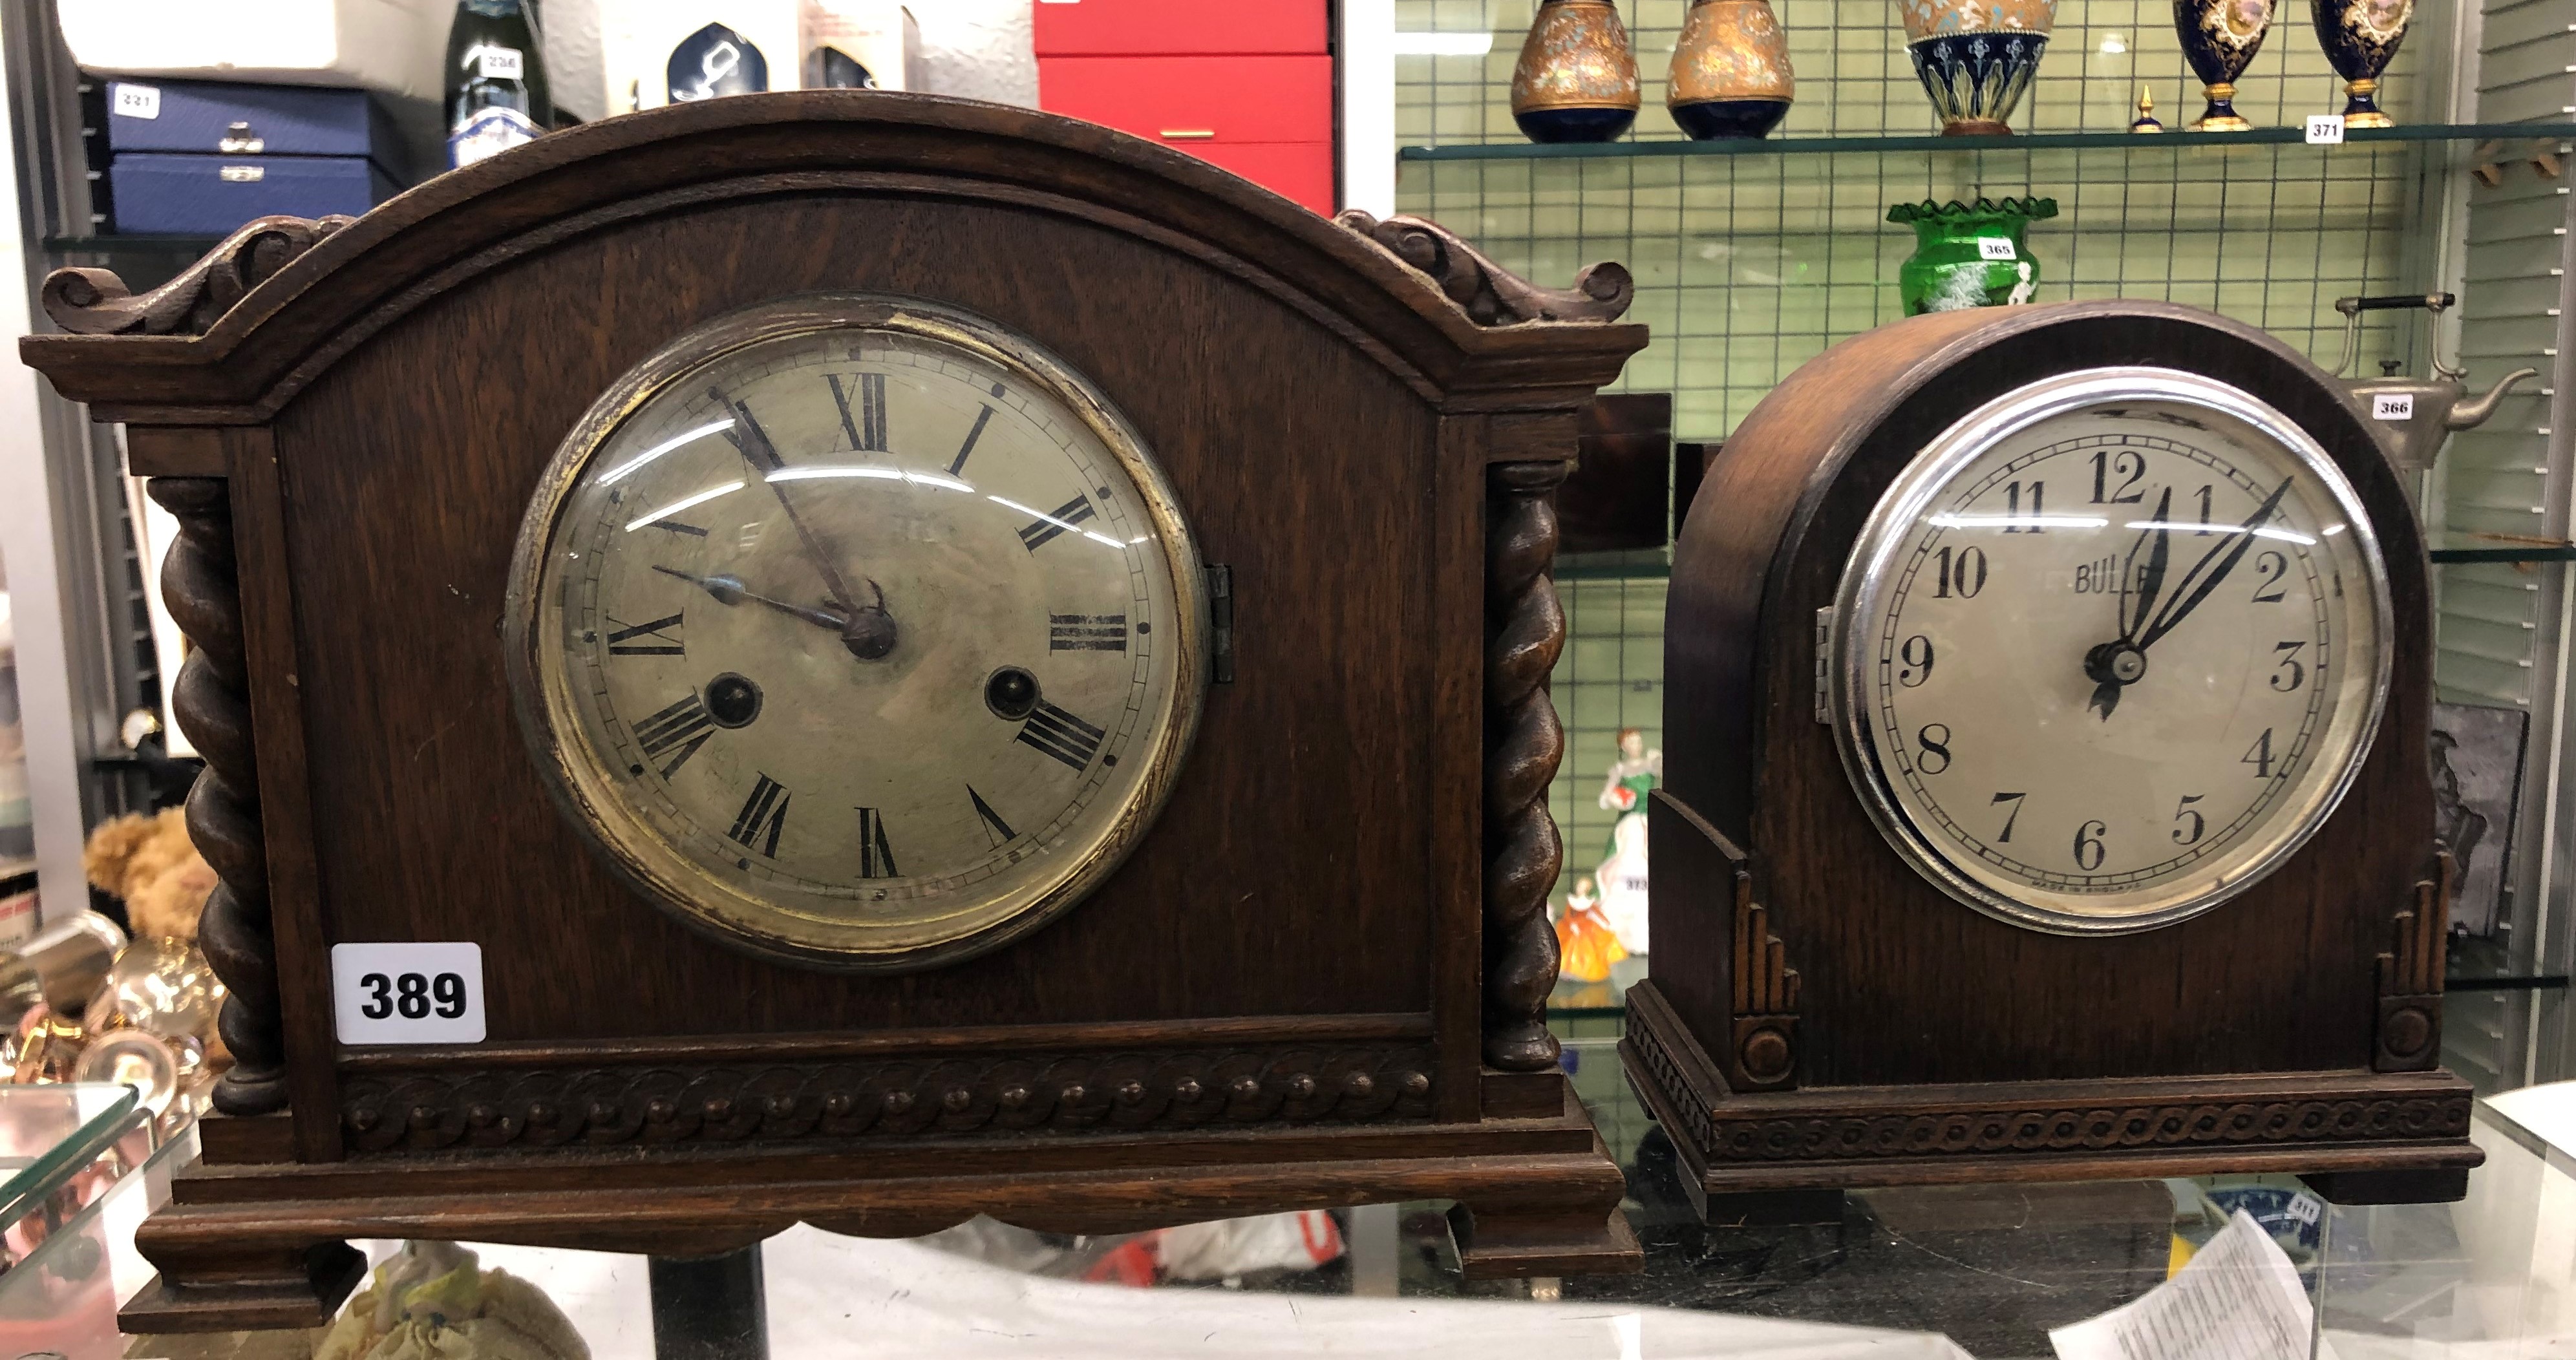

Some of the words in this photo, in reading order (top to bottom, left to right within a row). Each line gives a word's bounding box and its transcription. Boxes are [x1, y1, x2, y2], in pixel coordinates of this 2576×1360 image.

[2314, 123, 2337, 137] 371
[1986, 244, 2011, 255] 365
[819, 372, 893, 454] XII
[2381, 401, 2409, 414] 366
[2089, 451, 2146, 504] 12
[2003, 480, 2046, 534] 11
[2194, 485, 2213, 536] 1
[1932, 546, 1988, 599] 10
[2251, 551, 2288, 603] 2
[1899, 635, 1934, 688] 9
[2270, 641, 2306, 692] 3
[1917, 723, 1952, 775] 8
[2241, 727, 2277, 778] 4
[1990, 792, 2027, 843] 7
[2172, 793, 2206, 845] 5
[2073, 820, 2107, 871] 6
[360, 972, 467, 1019] 389
